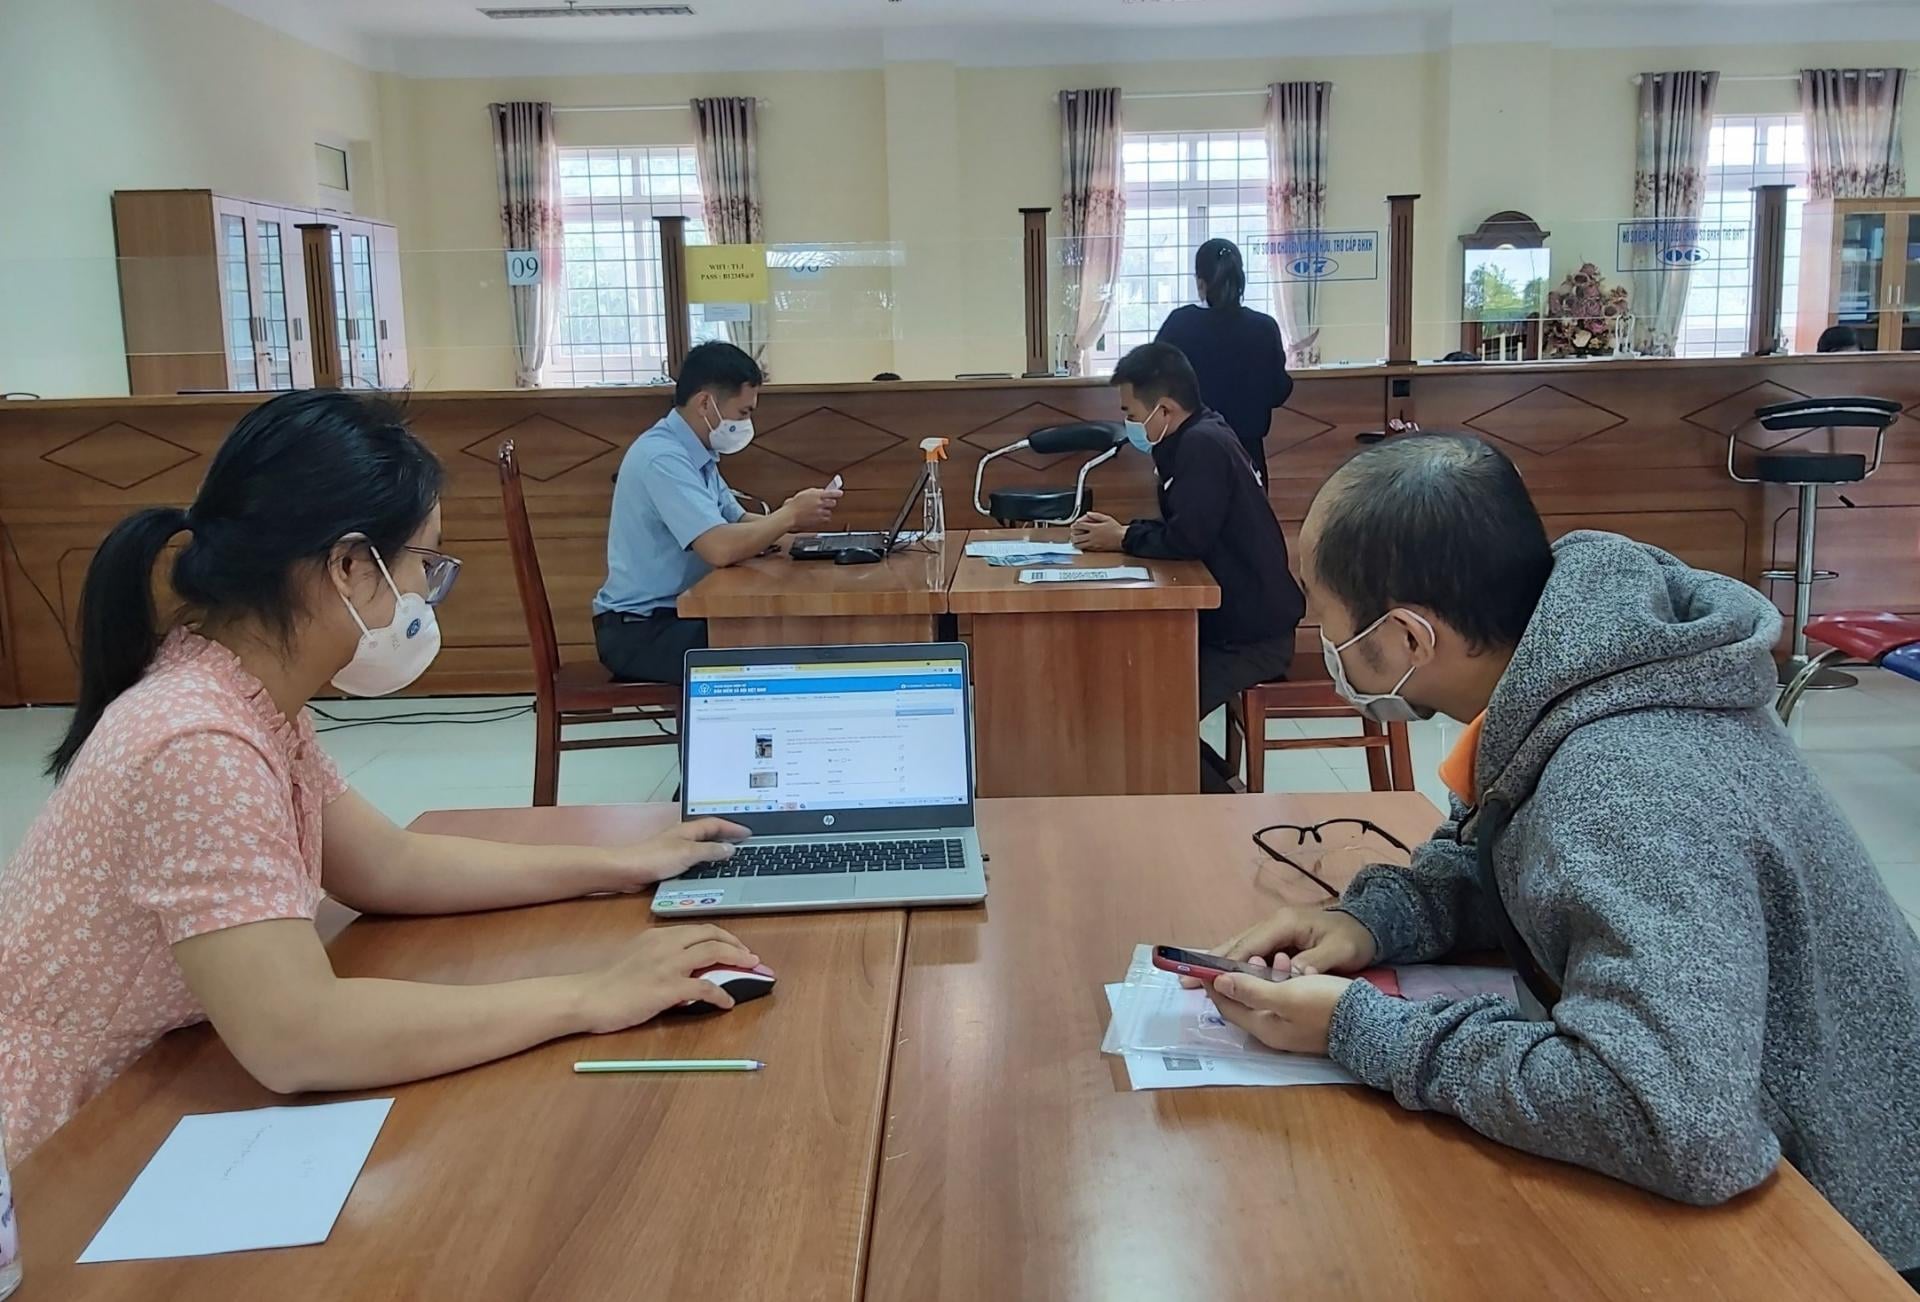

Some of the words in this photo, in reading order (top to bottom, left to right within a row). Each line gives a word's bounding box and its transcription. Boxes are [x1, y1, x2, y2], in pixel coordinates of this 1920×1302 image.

[1357, 239, 1373, 252] BHXH
[1666, 250, 1701, 261] 06
[512, 256, 538, 279] 09
[1294, 260, 1327, 274] 07
